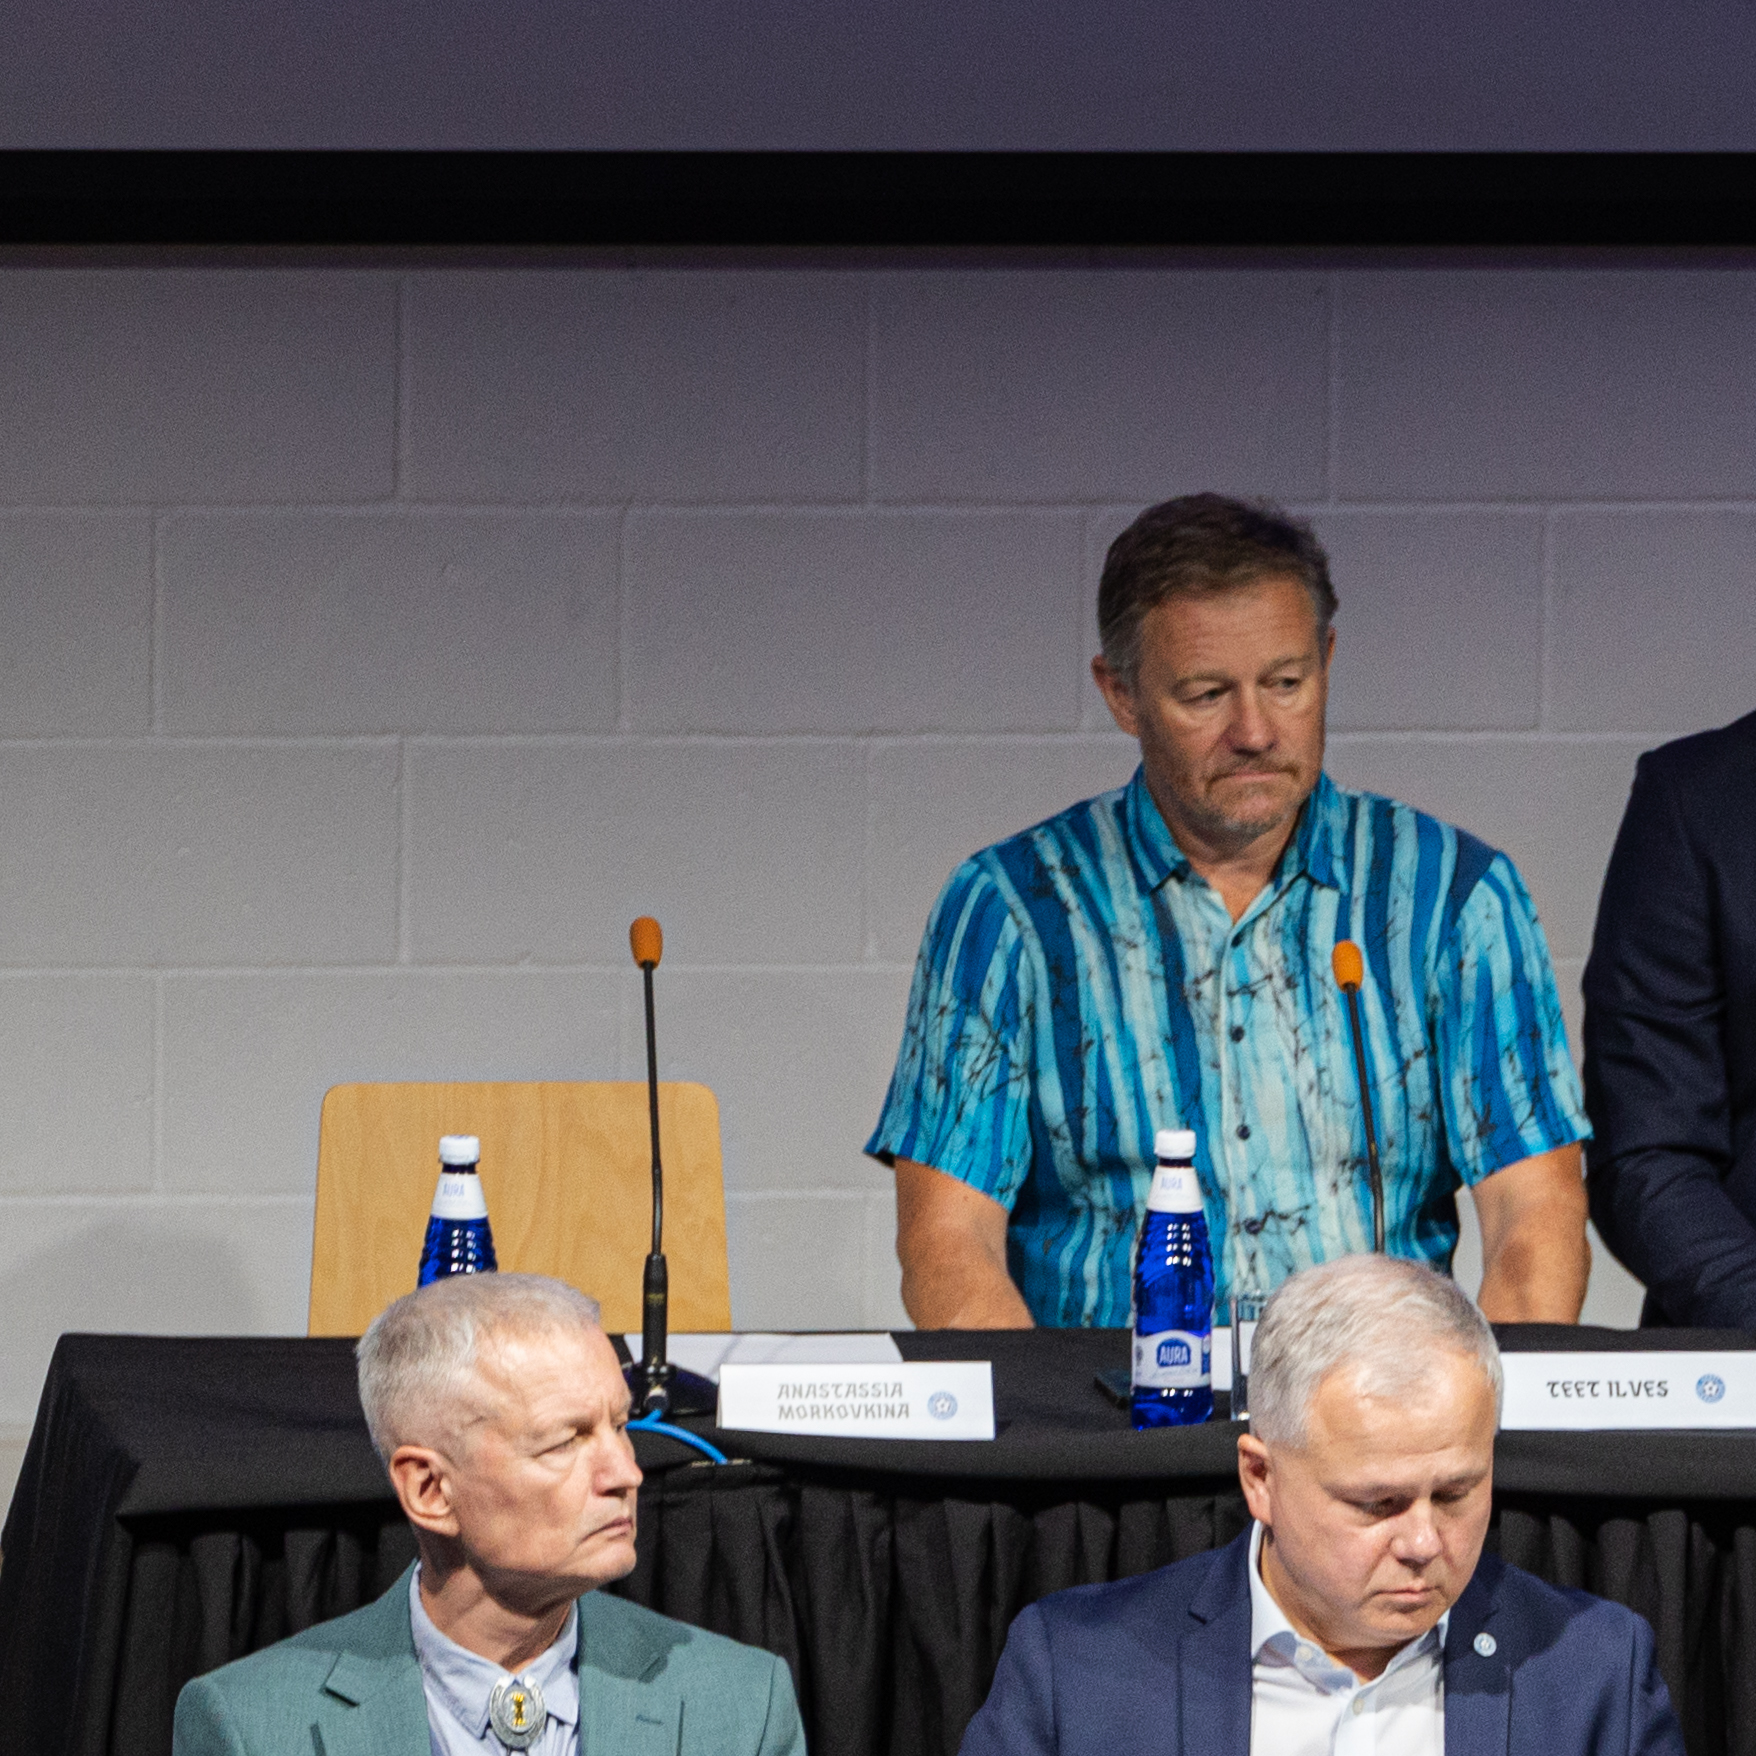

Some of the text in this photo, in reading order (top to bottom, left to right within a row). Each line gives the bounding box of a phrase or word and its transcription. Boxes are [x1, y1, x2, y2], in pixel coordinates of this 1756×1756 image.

[1160, 1346, 1188, 1362] AURA
[777, 1382, 903, 1399] ANASTASSIA
[1547, 1380, 1668, 1398] TEET ILVES
[777, 1402, 910, 1420] MORKOVKINA
